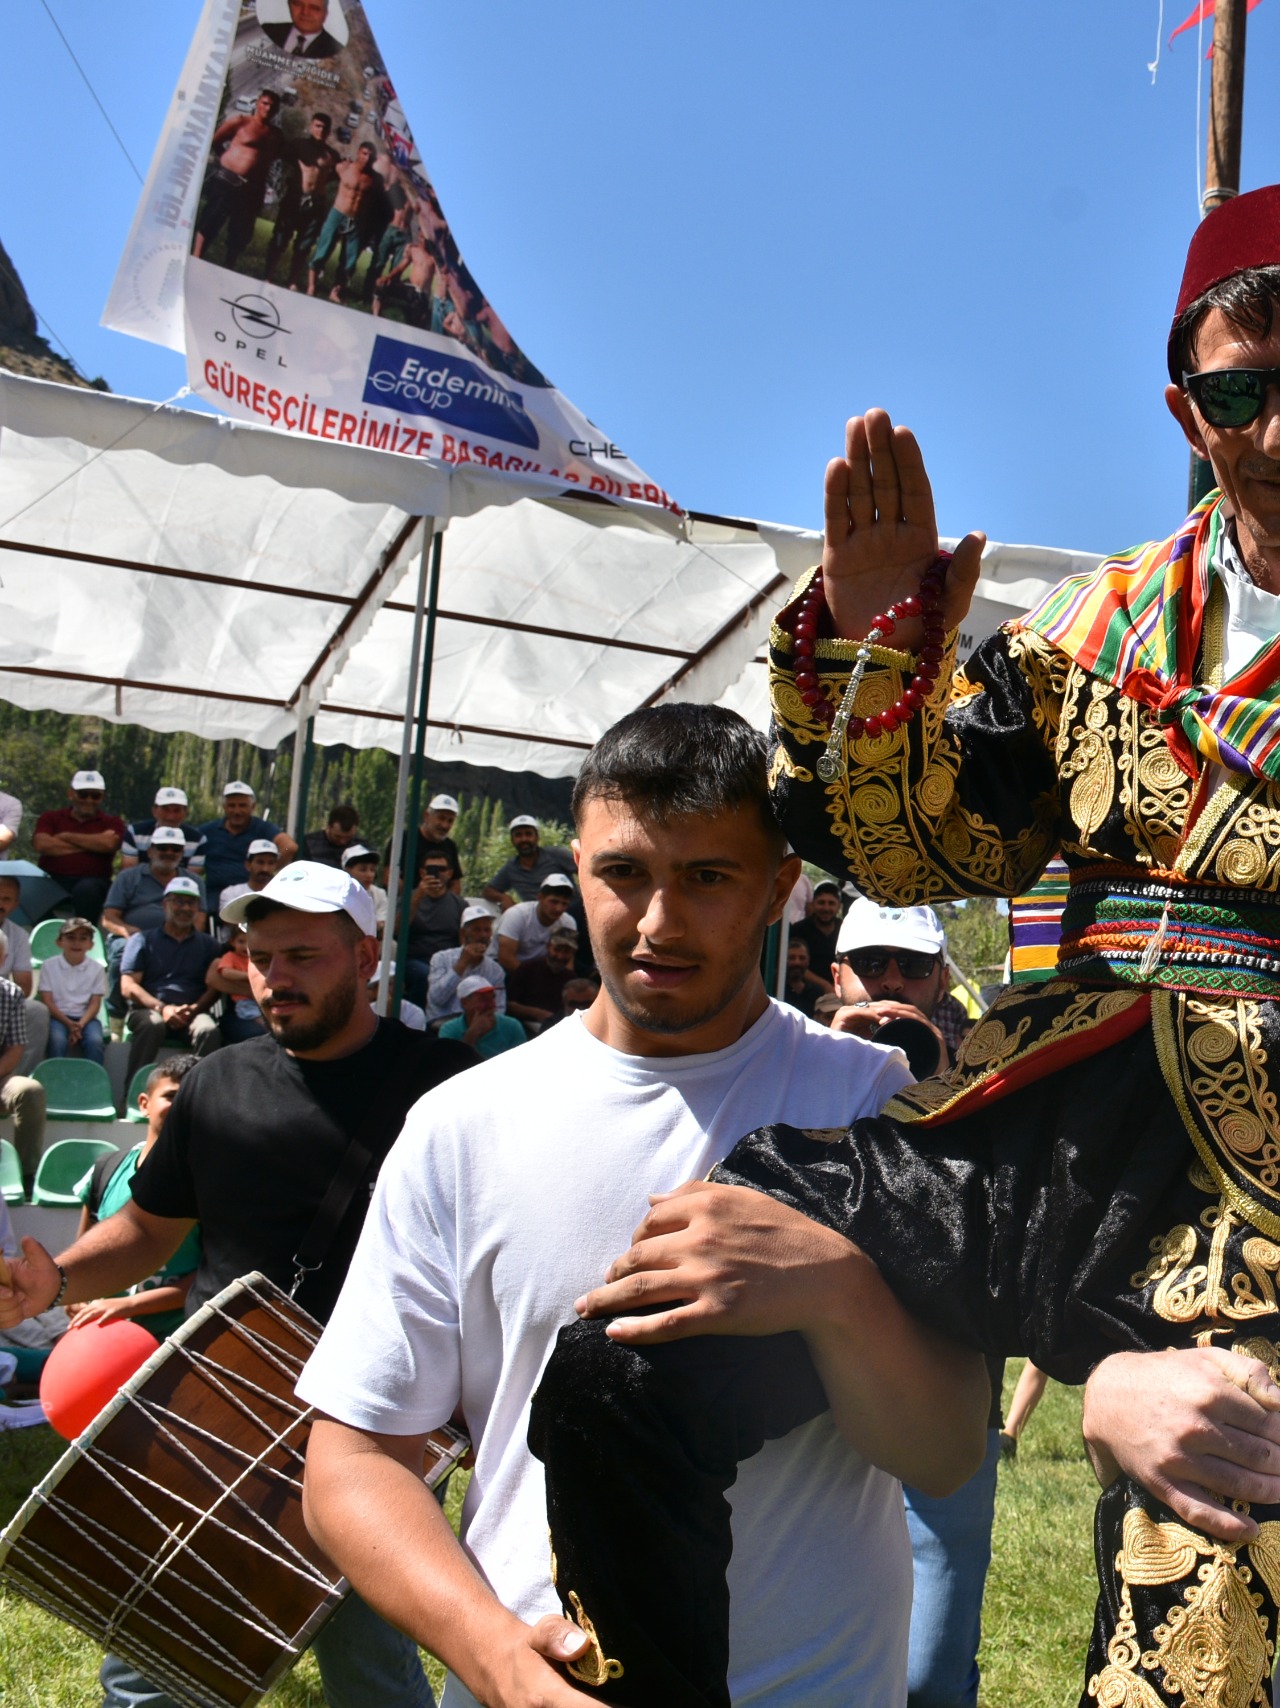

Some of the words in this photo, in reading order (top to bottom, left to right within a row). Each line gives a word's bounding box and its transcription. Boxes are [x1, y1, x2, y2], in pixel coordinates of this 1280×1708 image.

[214, 330, 288, 368] OPEL
[204, 359, 433, 456] GÜREŞÇİLERİMİZE
[368, 371, 452, 409] Group
[569, 440, 628, 459] CHE
